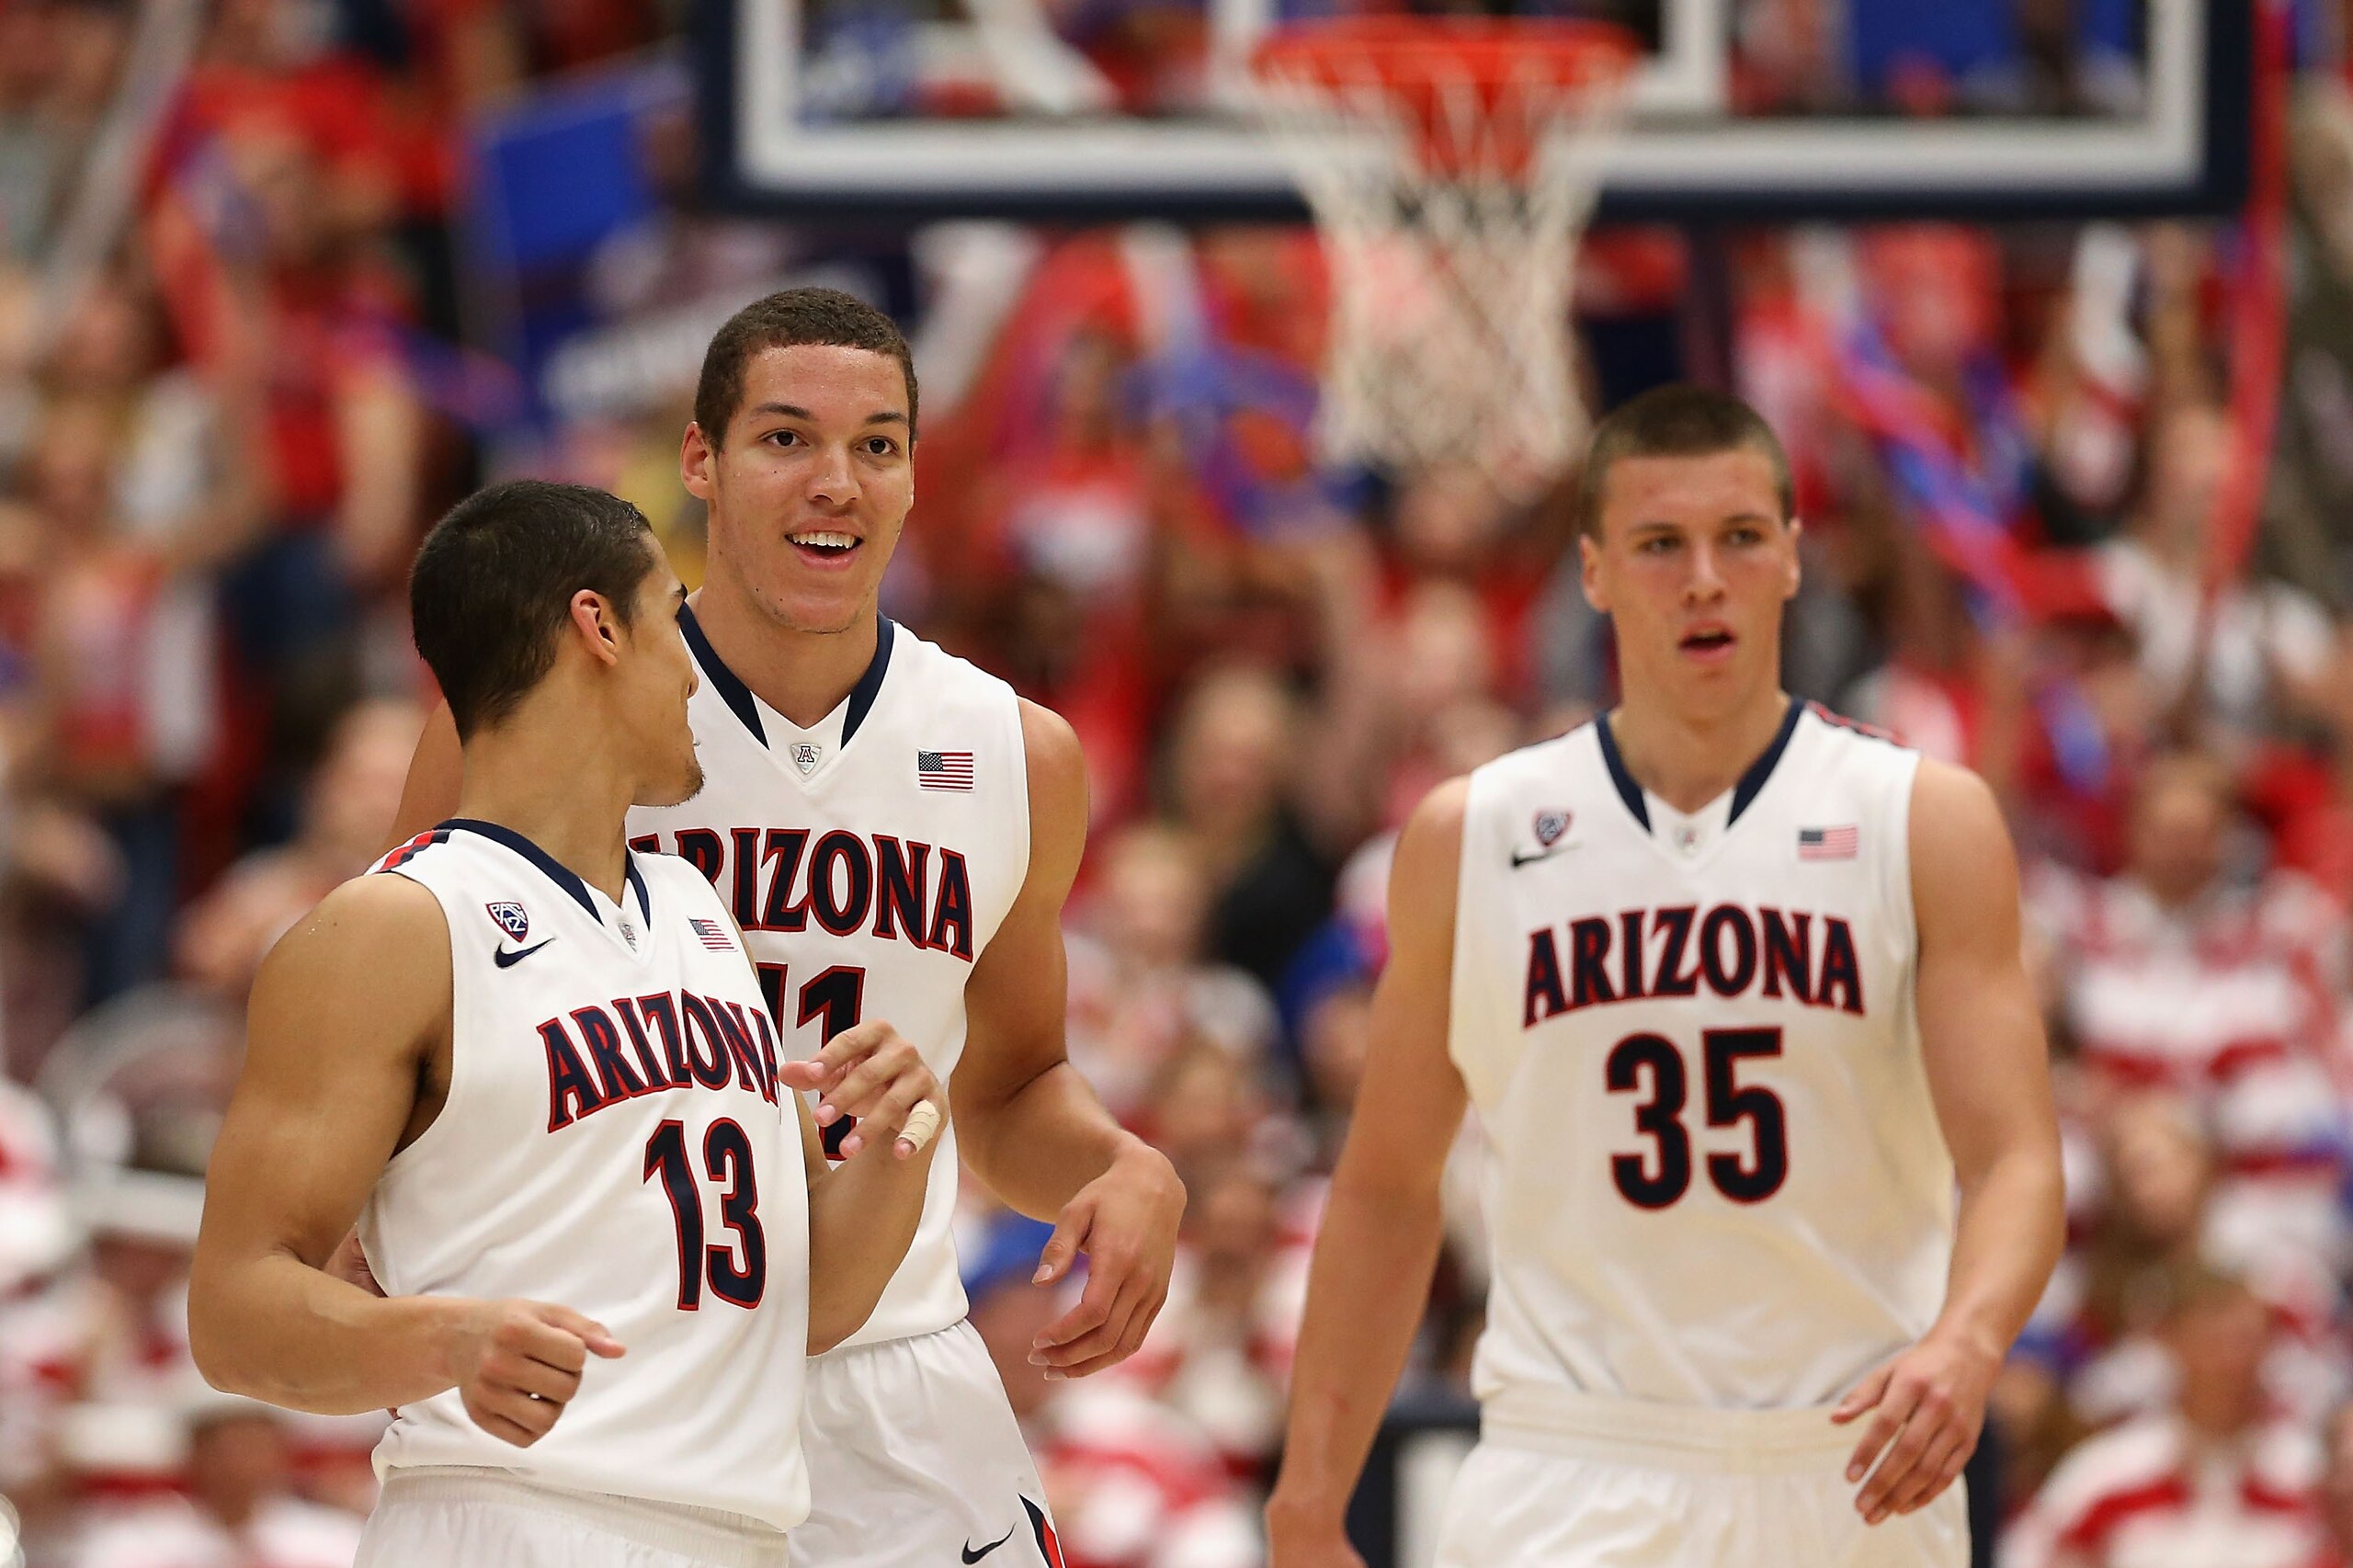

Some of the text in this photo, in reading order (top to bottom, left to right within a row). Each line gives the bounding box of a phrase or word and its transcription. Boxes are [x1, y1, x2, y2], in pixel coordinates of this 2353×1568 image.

[798, 745, 815, 763] A
[504, 916, 526, 932] 12
[1522, 903, 1866, 1030] ARIZONA
[1605, 1026, 1789, 1213] 35
[643, 1117, 767, 1311] 13
